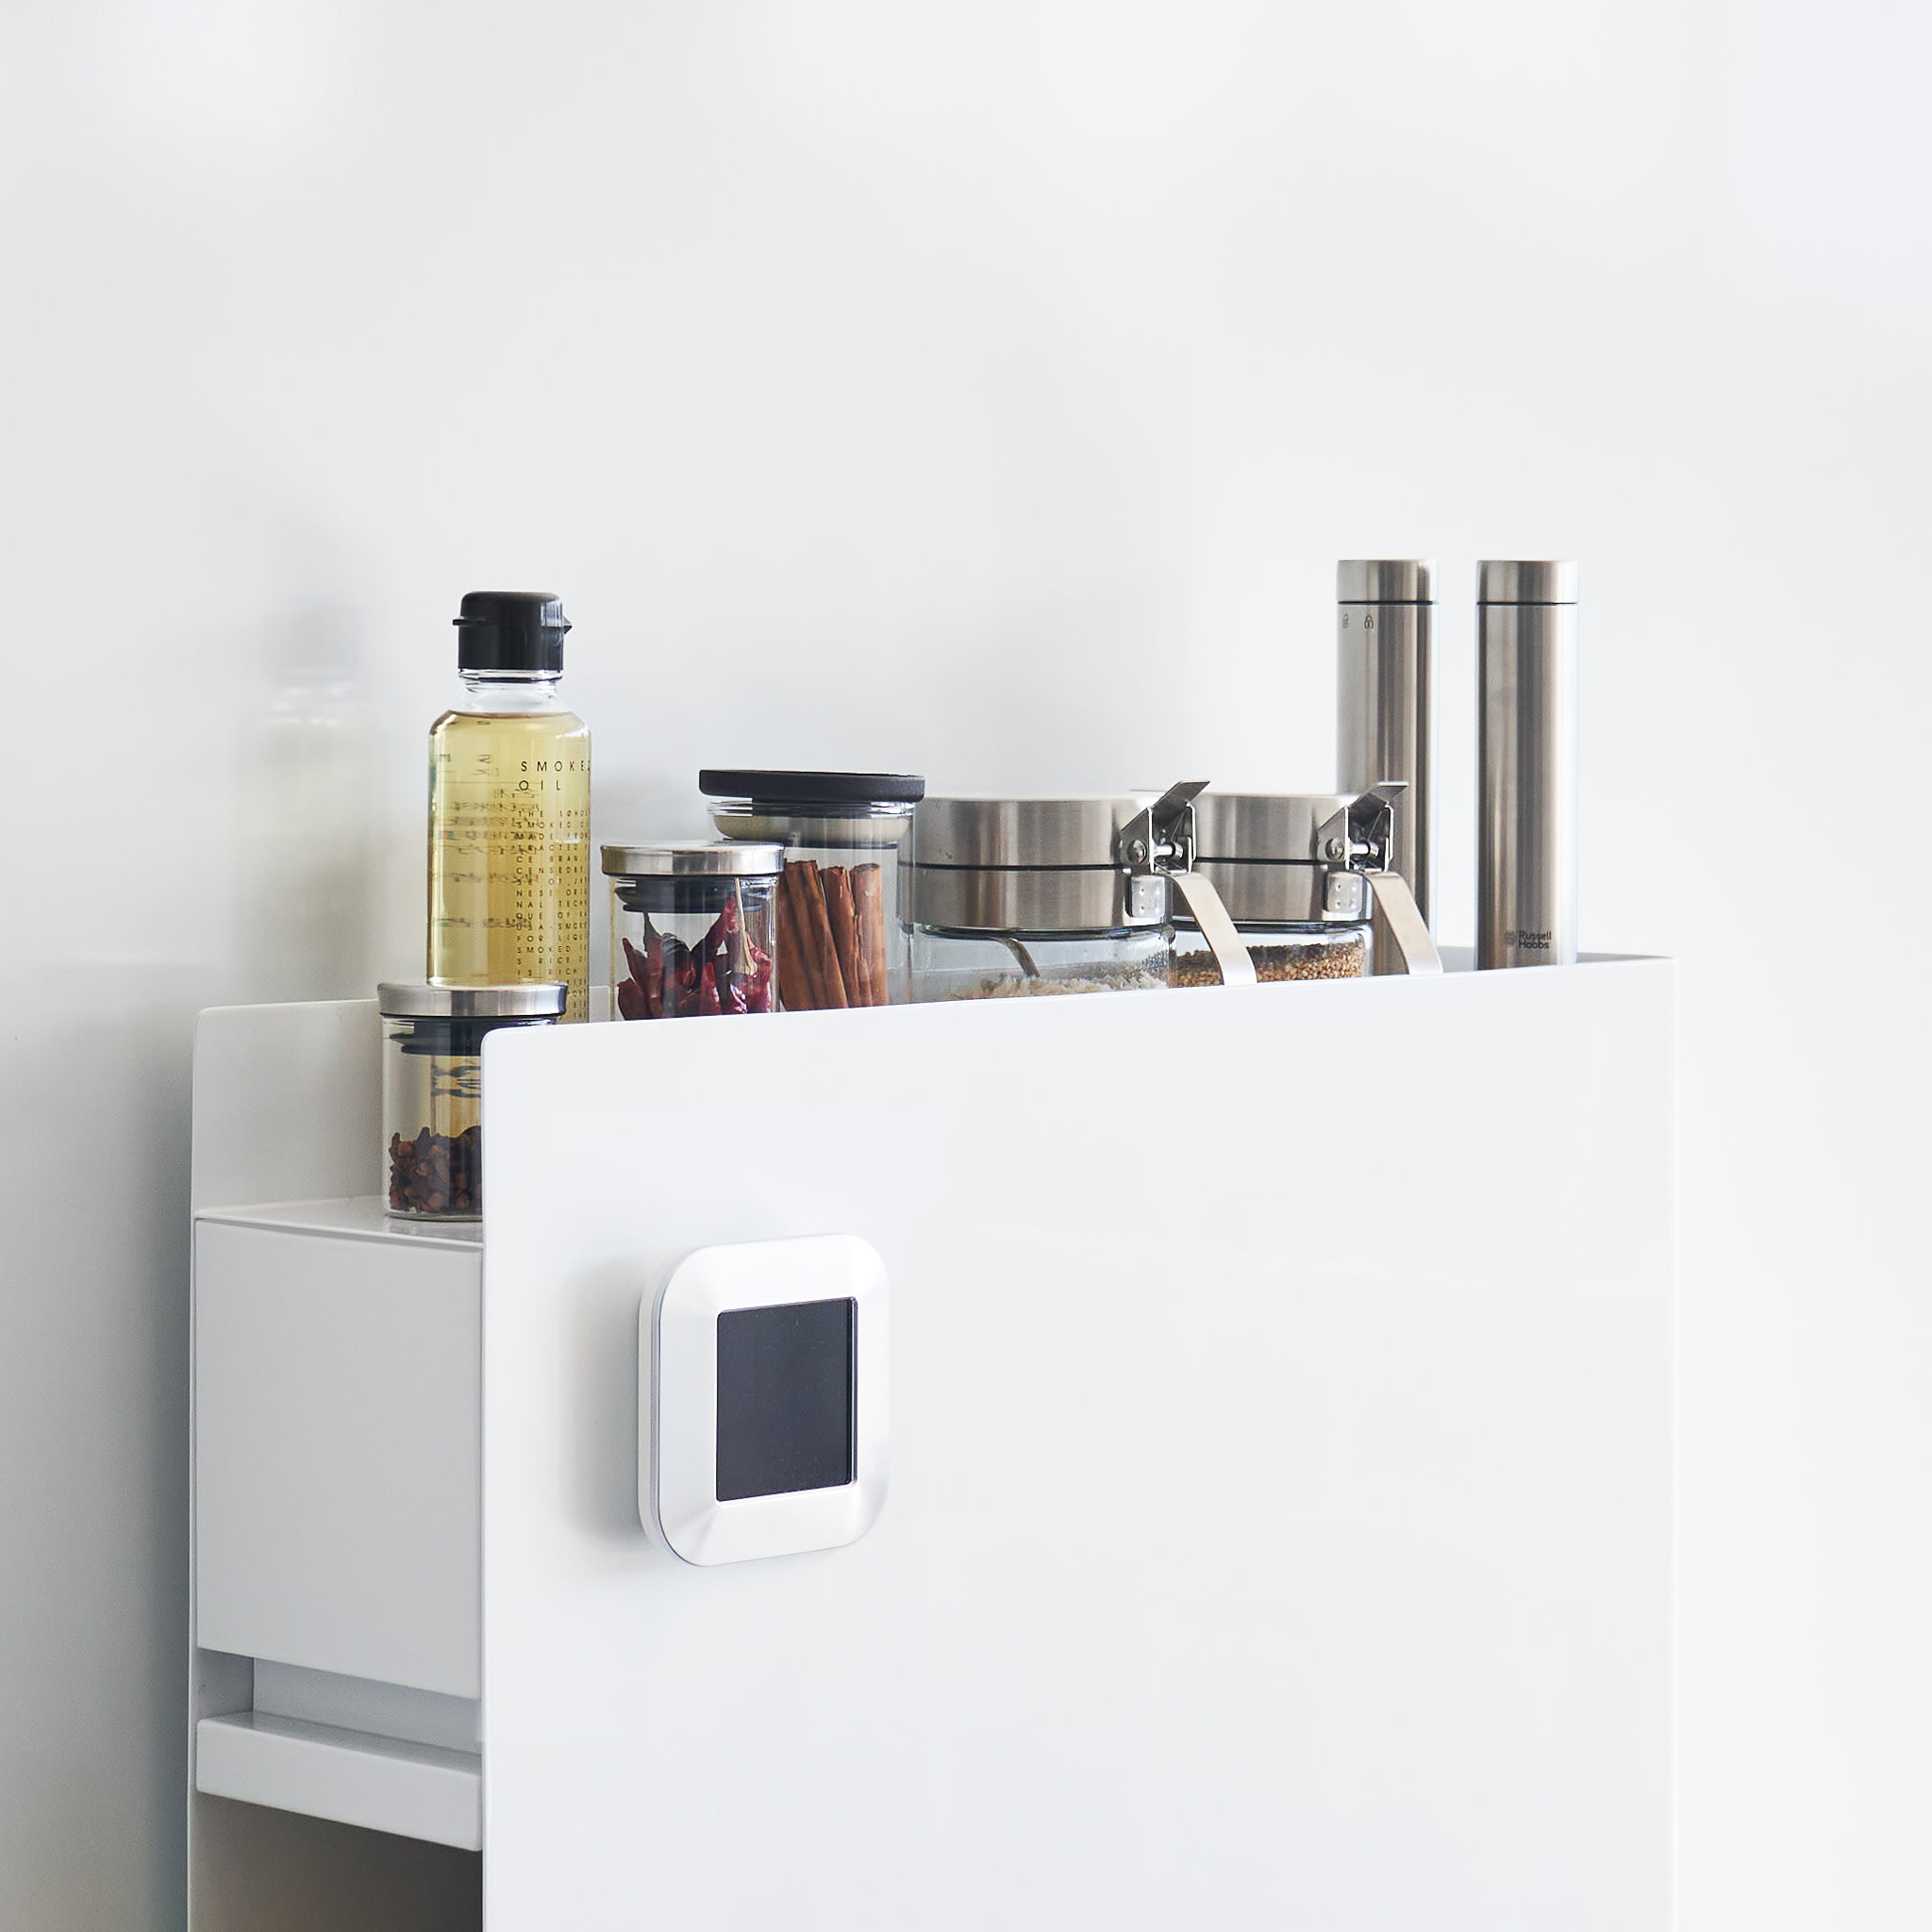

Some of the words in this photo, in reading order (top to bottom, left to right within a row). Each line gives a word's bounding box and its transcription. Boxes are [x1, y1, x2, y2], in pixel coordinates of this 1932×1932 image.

[518, 779, 561, 791] OIL
[516, 901, 544, 909] NAL
[515, 911, 544, 921] QUE
[517, 934, 545, 943] FOR
[1519, 930, 1552, 941] Russell
[1518, 939, 1549, 949] Hobbs
[517, 945, 572, 955] SMOKED
[518, 968, 533, 977] IS
